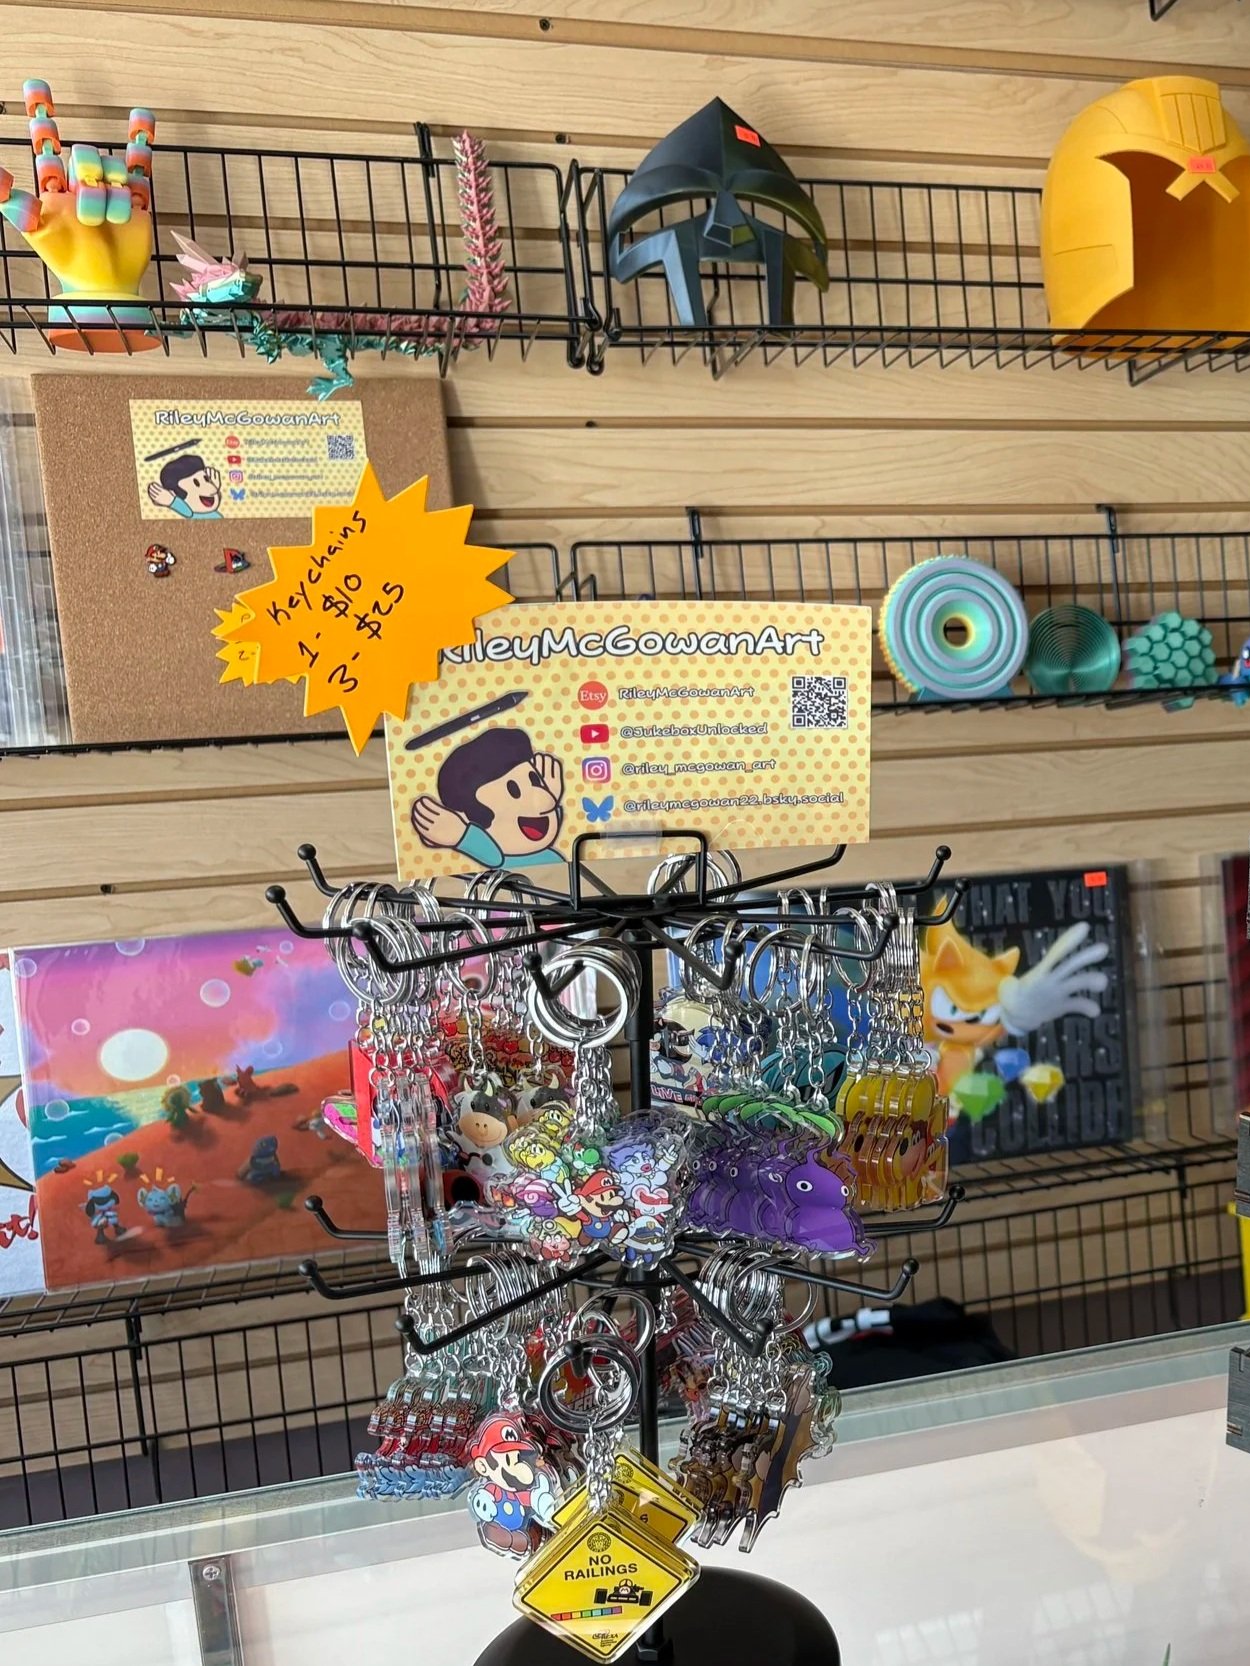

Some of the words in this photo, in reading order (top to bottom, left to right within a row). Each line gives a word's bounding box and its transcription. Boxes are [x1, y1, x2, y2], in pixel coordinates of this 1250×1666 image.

[154, 410, 341, 428] RileyMcGowanArt
[266, 510, 367, 626] Keychains
[321, 573, 363, 619] $10
[353, 581, 405, 641] $25
[579, 689, 608, 703] Etsy
[618, 685, 755, 701] RileyMcGowanArt
[620, 722, 769, 739] @JukeboxUnlocked
[622, 758, 777, 777] @riley_mcgowan_art
[623, 792, 844, 815] @rileymcgowan22.bsky.social
[588, 1554, 612, 1567] NO
[564, 1563, 638, 1581] RAILINGS
